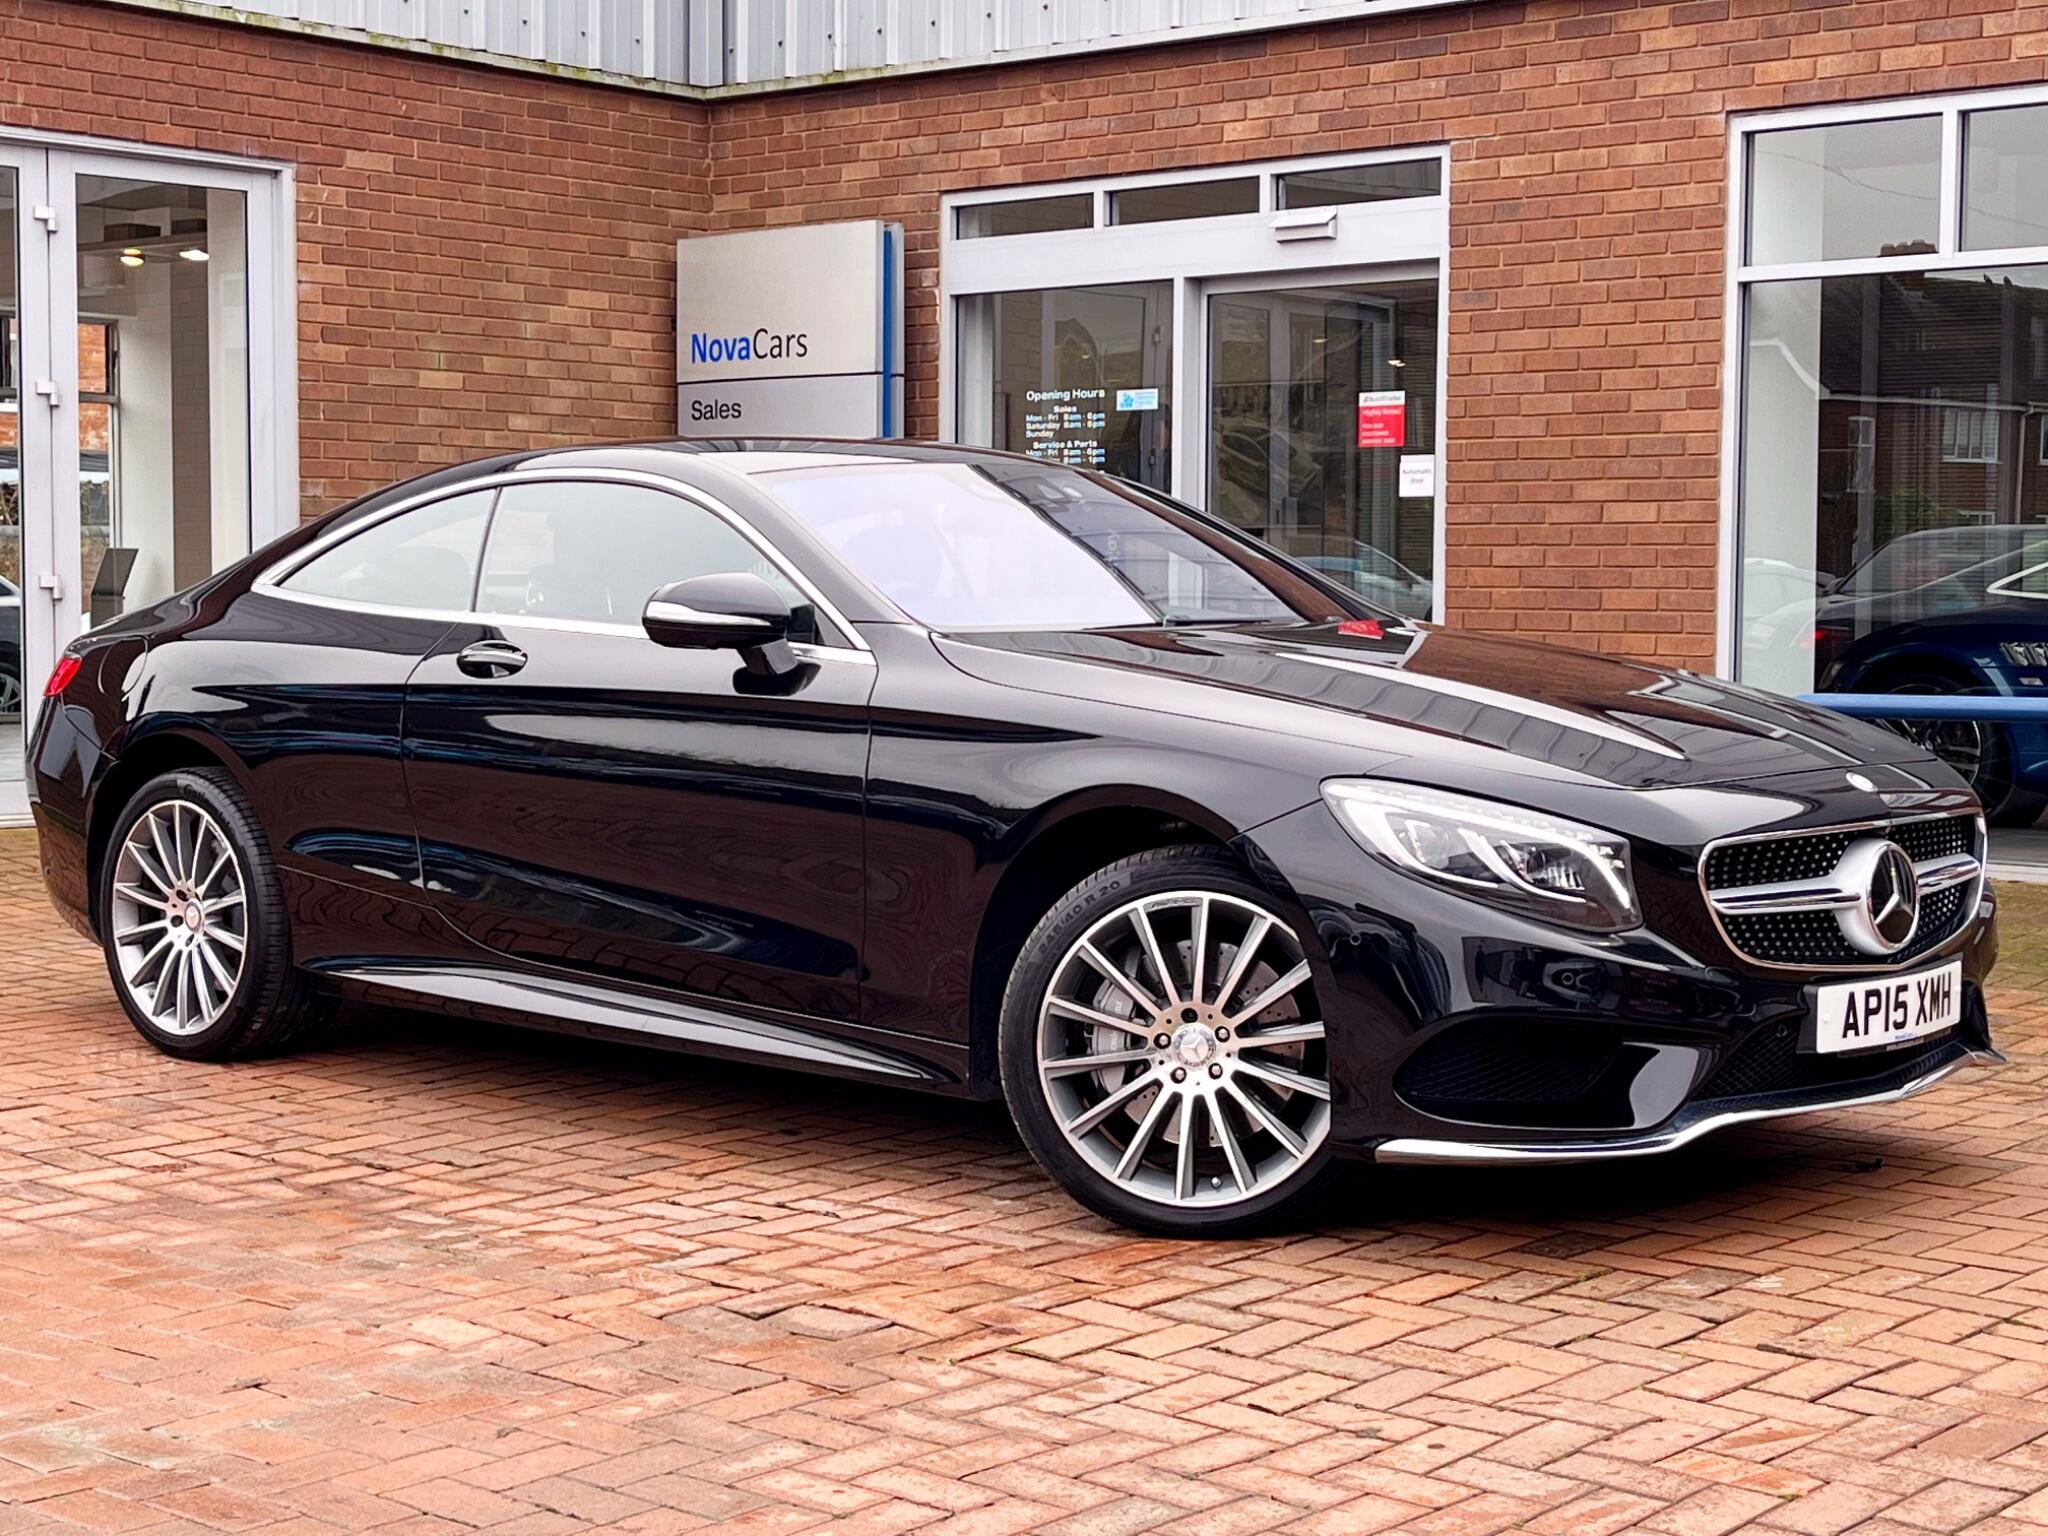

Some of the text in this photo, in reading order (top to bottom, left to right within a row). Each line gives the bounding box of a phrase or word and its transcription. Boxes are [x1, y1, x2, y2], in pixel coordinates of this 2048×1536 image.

[691, 328, 808, 364] NovaCars
[1026, 388, 1106, 402] Opening Hours
[691, 399, 742, 421] Sales
[1053, 405, 1077, 413] Sales
[1025, 414, 1042, 422] Mon
[1048, 413, 1059, 421] Fri
[1025, 422, 1061, 430] Saturday
[1025, 430, 1055, 439] Sunday
[1033, 441, 1066, 449] Service
[1074, 440, 1098, 448] Parts
[1025, 449, 1042, 457] Mon
[1099, 880, 1121, 894] 20
[1842, 972, 1951, 1038] AP15 XMH
